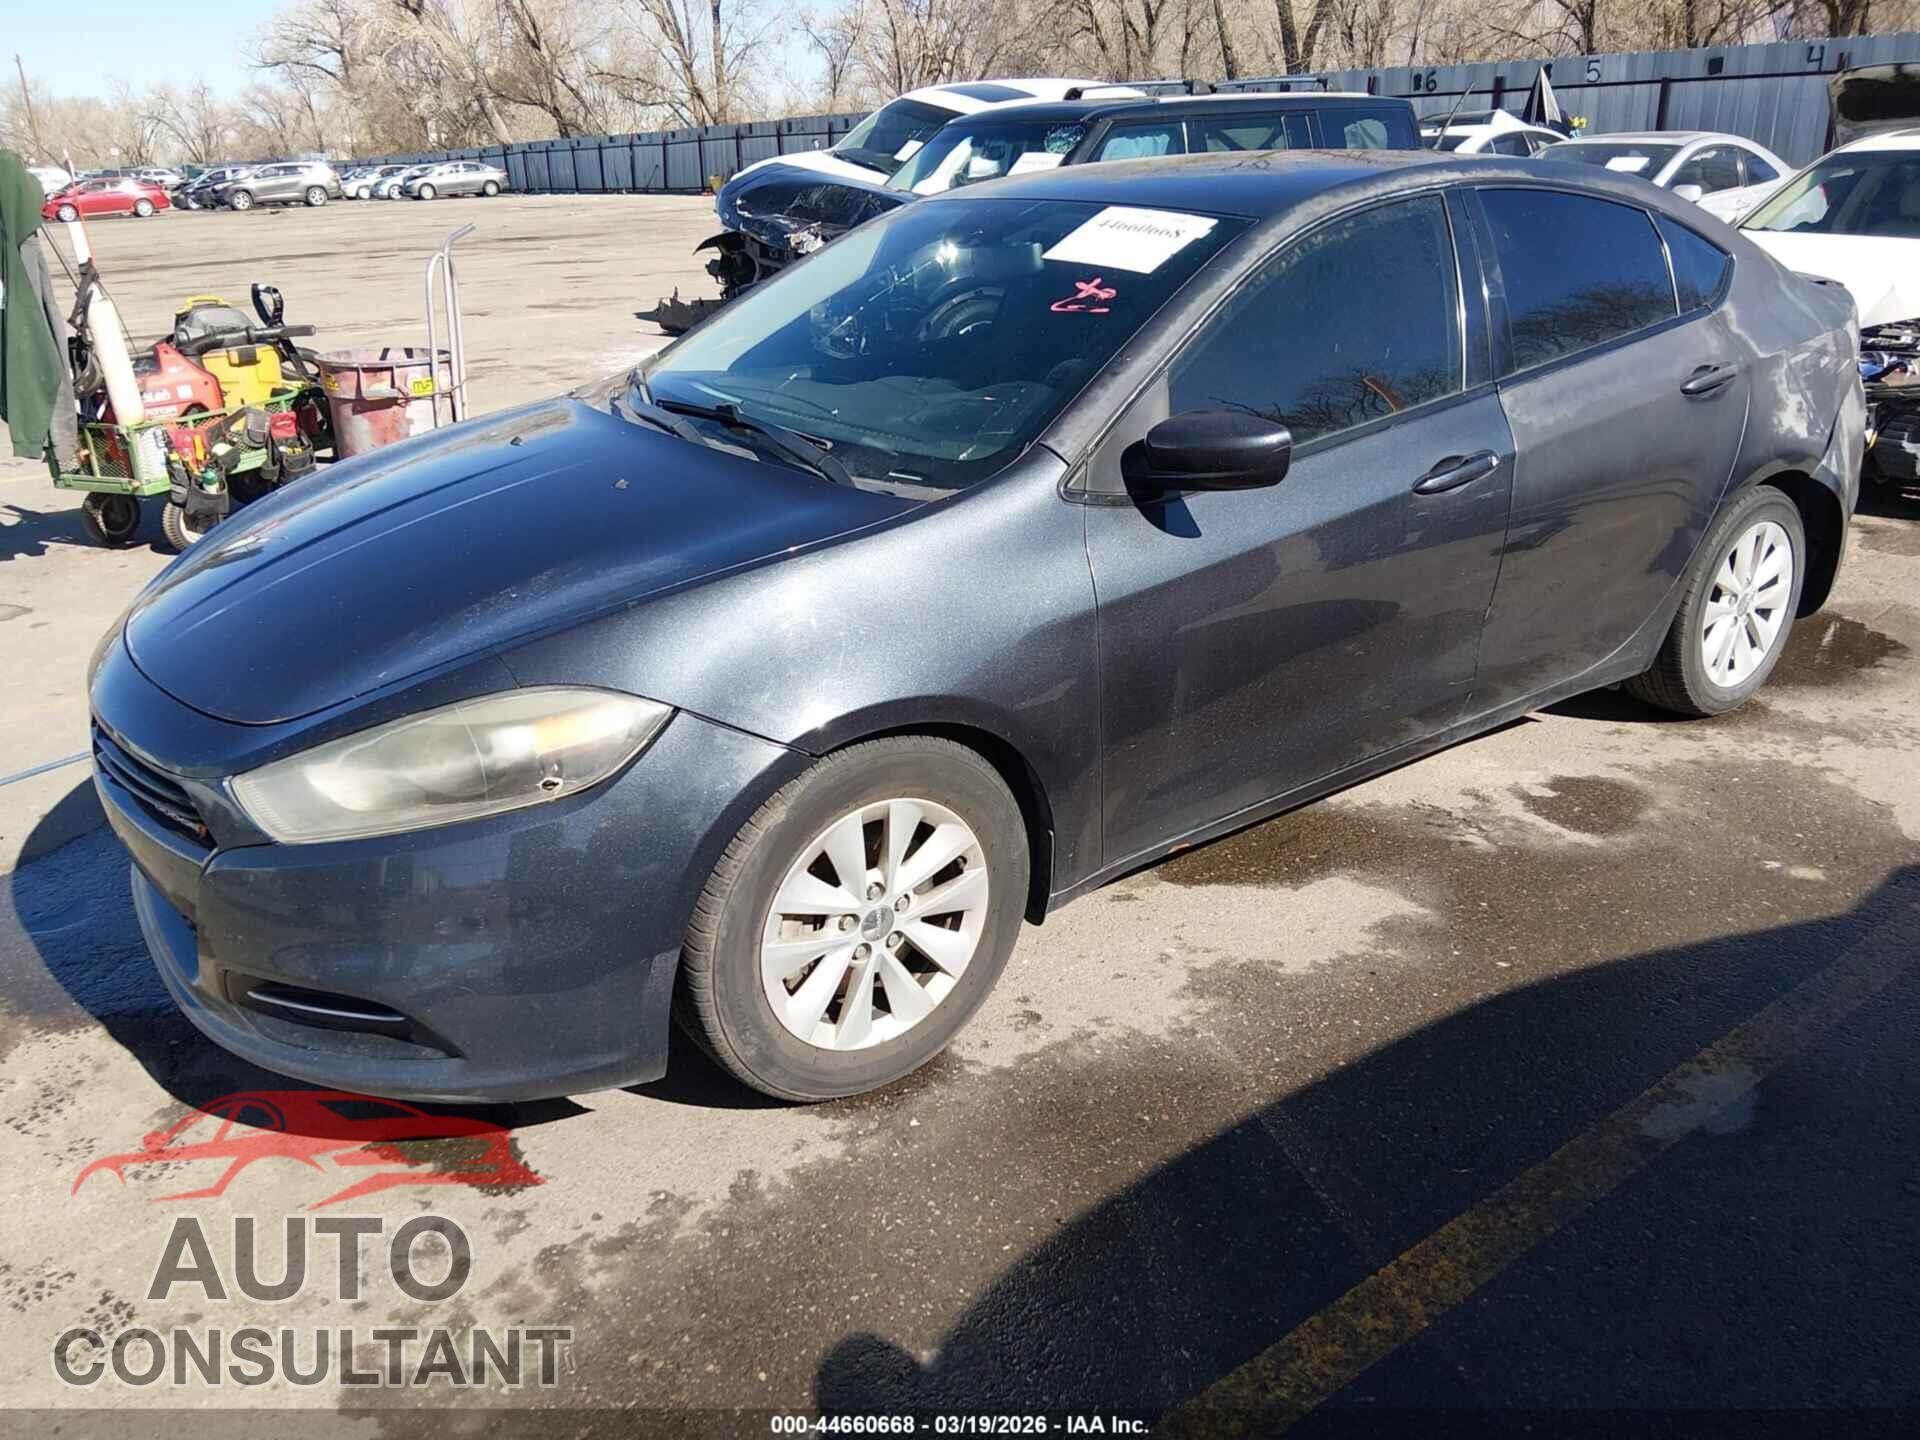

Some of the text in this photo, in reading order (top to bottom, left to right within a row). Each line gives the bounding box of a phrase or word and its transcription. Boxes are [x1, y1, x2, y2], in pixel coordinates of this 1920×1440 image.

[1806, 45, 1825, 72] 4
[1425, 71, 1438, 92] 6
[1586, 59, 1601, 83] 5
